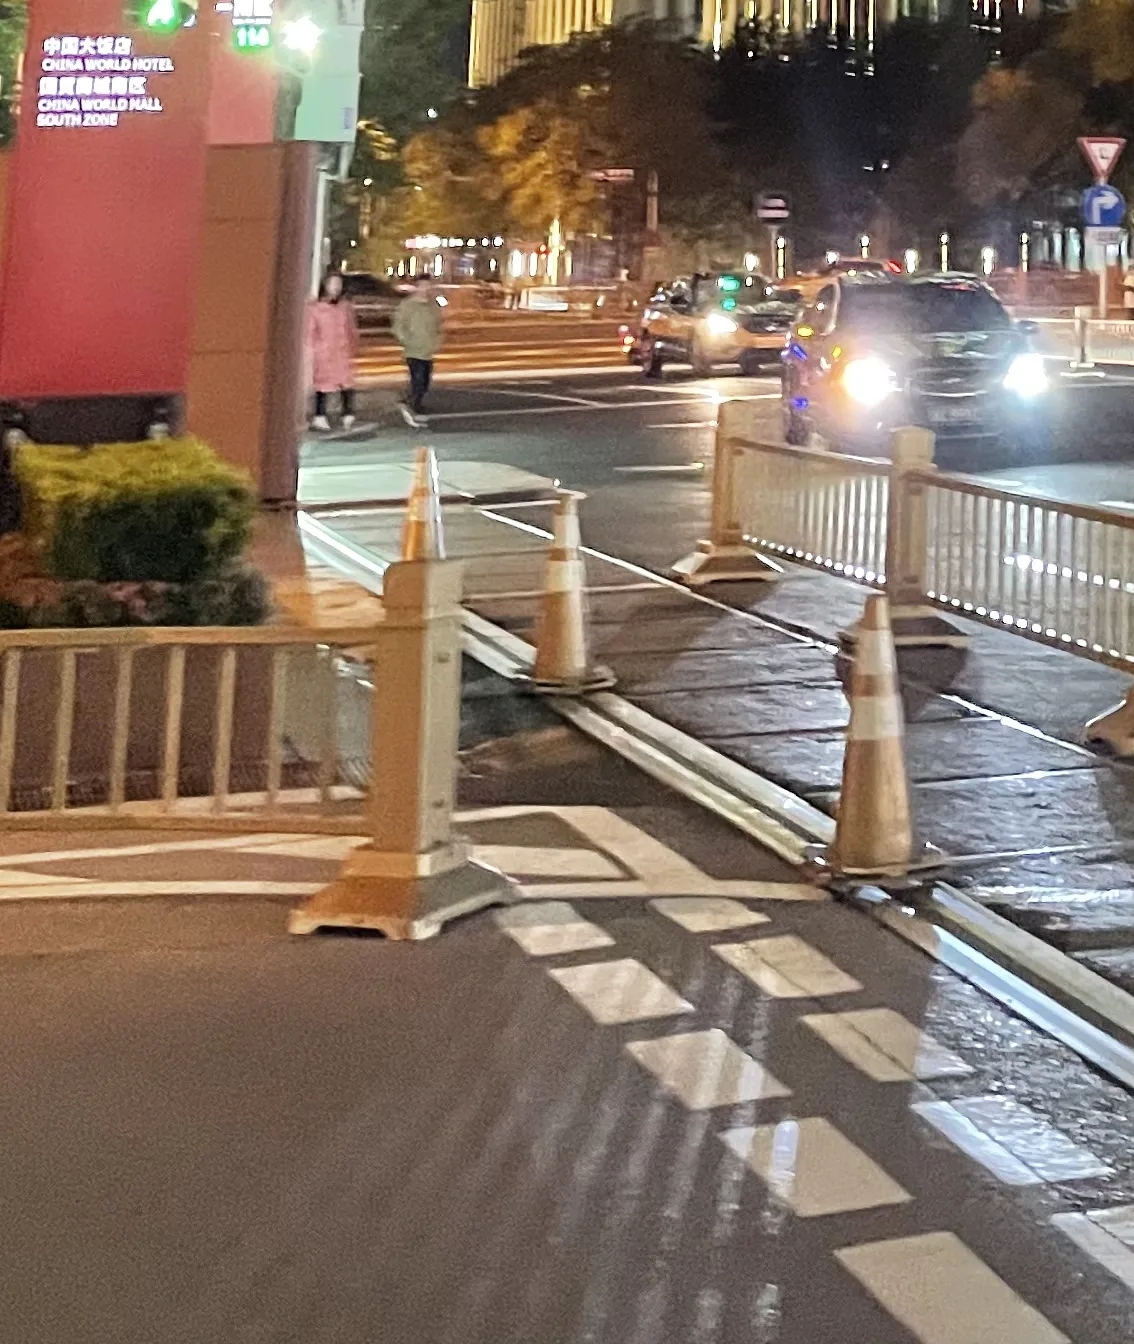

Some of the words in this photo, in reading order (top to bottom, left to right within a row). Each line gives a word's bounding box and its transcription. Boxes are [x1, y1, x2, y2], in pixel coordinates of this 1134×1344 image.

[43, 37, 132, 56] 中国大饭店
[42, 58, 84, 72] CHINA
[84, 58, 131, 72] WORLD
[132, 57, 174, 72] HOTEL
[37, 98, 80, 112] CHINA
[81, 98, 128, 112] WORLD
[129, 97, 163, 111] MALL
[36, 113, 82, 127] SOUTH
[82, 113, 119, 126] ZONE
